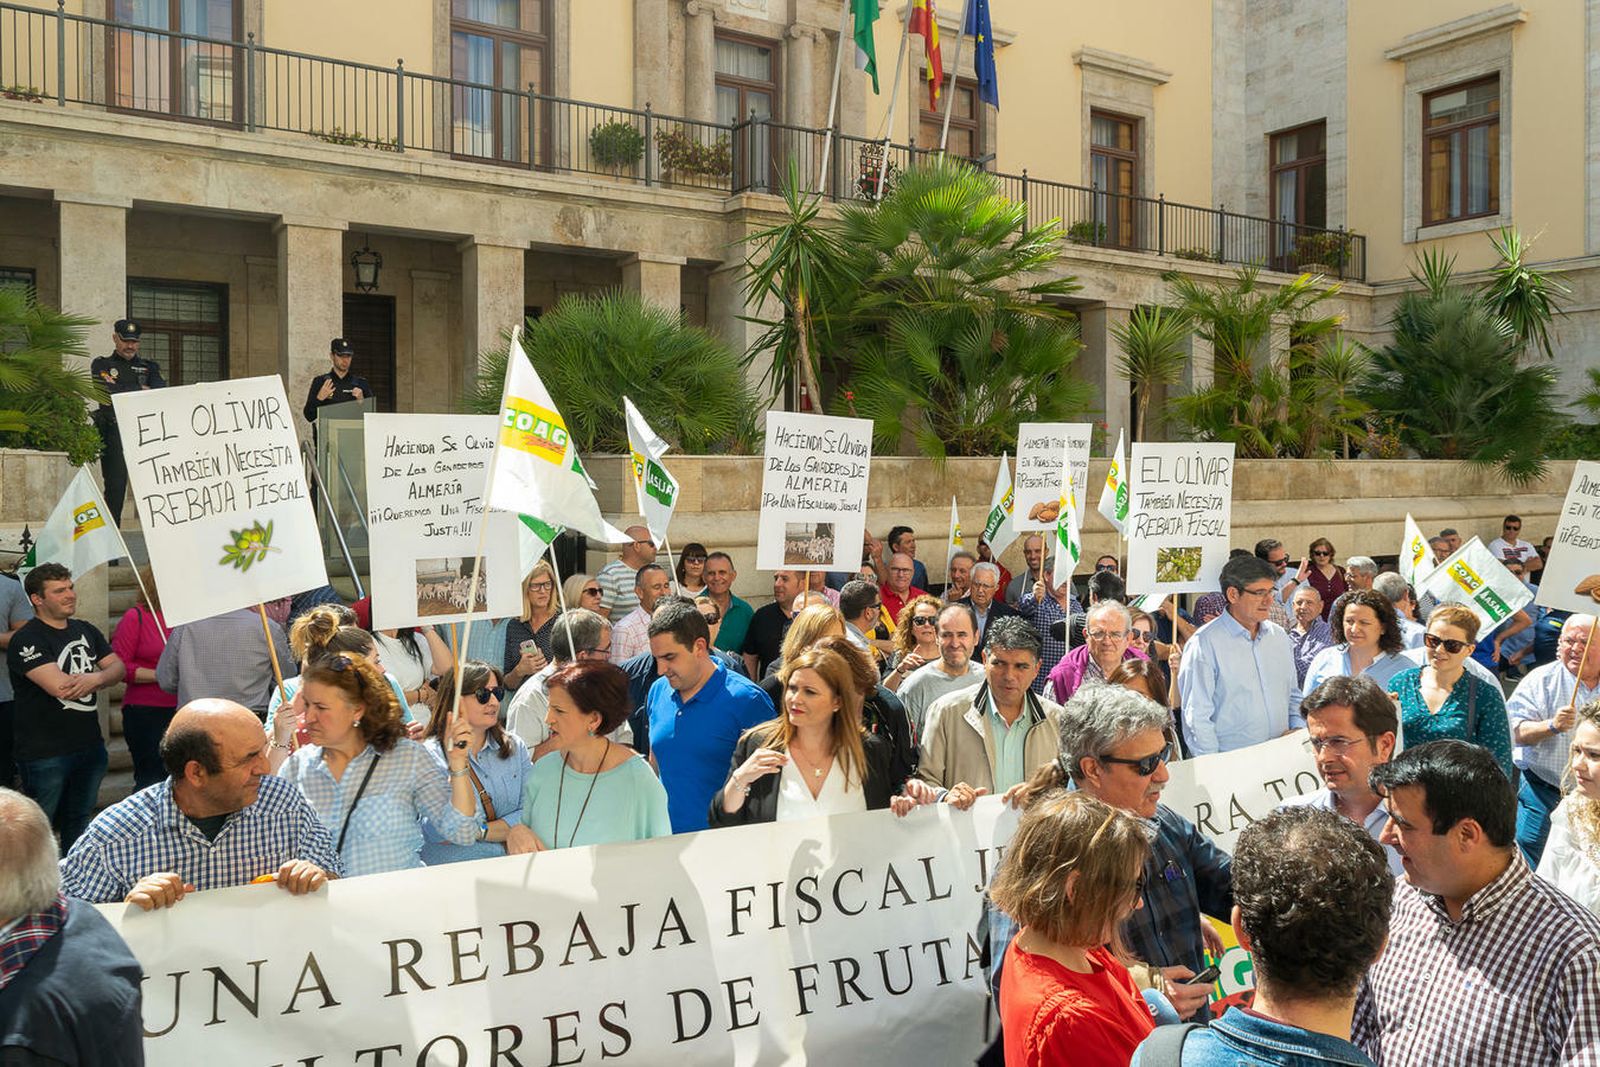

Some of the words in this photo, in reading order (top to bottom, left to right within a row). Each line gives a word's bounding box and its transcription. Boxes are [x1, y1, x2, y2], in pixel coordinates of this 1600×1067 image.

[137, 411, 178, 446] EL
[191, 392, 288, 437] OLIVAR
[504, 408, 568, 447] COAG
[384, 435, 435, 458] HACIENDA
[775, 426, 822, 451] HACIENDA
[838, 432, 868, 458] OLVIDA
[225, 442, 294, 475] NECESITA
[382, 466, 402, 479] DE
[433, 461, 484, 474] GANADEROS
[769, 457, 783, 471] DE
[804, 456, 850, 476] GANADEROS
[849, 462, 866, 478] DE
[1141, 456, 1170, 483] EL
[1175, 451, 1229, 487] OLIVAR
[143, 480, 237, 528] REBAJA
[243, 470, 305, 509] FISCAL
[408, 478, 463, 500] ALMERÍA
[780, 494, 796, 509] UNA
[1177, 490, 1223, 510] NECESITA
[1568, 502, 1587, 516] EN
[423, 521, 473, 537] JUSTA!!!
[1134, 513, 1183, 539] REBAJA
[1185, 510, 1227, 537] FISCAL
[1453, 563, 1480, 589] COAG
[140, 951, 341, 1038] UNA
[381, 896, 696, 998] REBAJA
[726, 856, 953, 938] FISCAL
[667, 976, 761, 1044] DE
